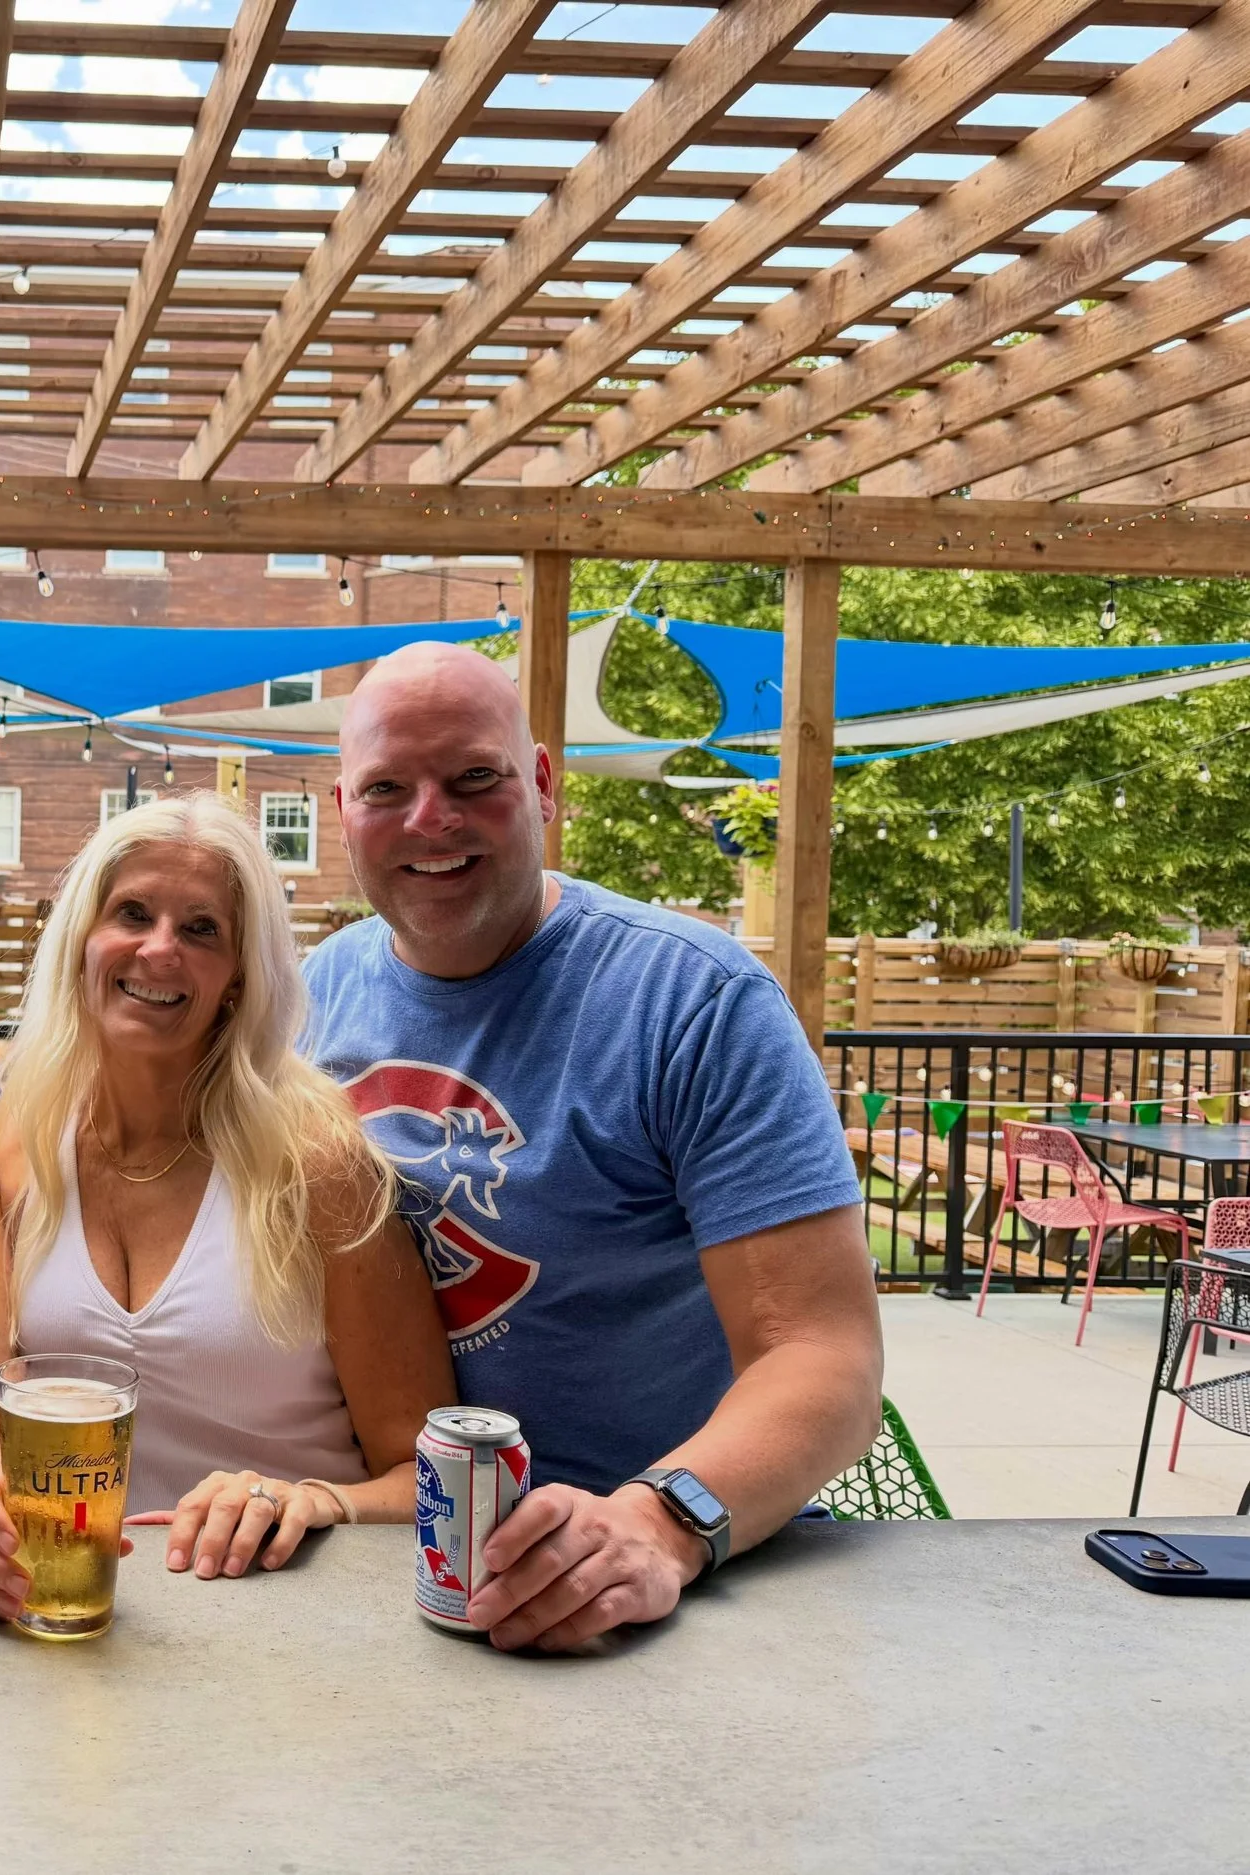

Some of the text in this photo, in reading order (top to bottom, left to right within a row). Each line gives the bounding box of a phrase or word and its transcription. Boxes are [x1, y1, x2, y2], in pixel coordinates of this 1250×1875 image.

[451, 1320, 511, 1357] EFEATED
[45, 1448, 117, 1469] Michelob
[32, 1466, 124, 1495] ULTRA
[417, 1465, 432, 1489] bst
